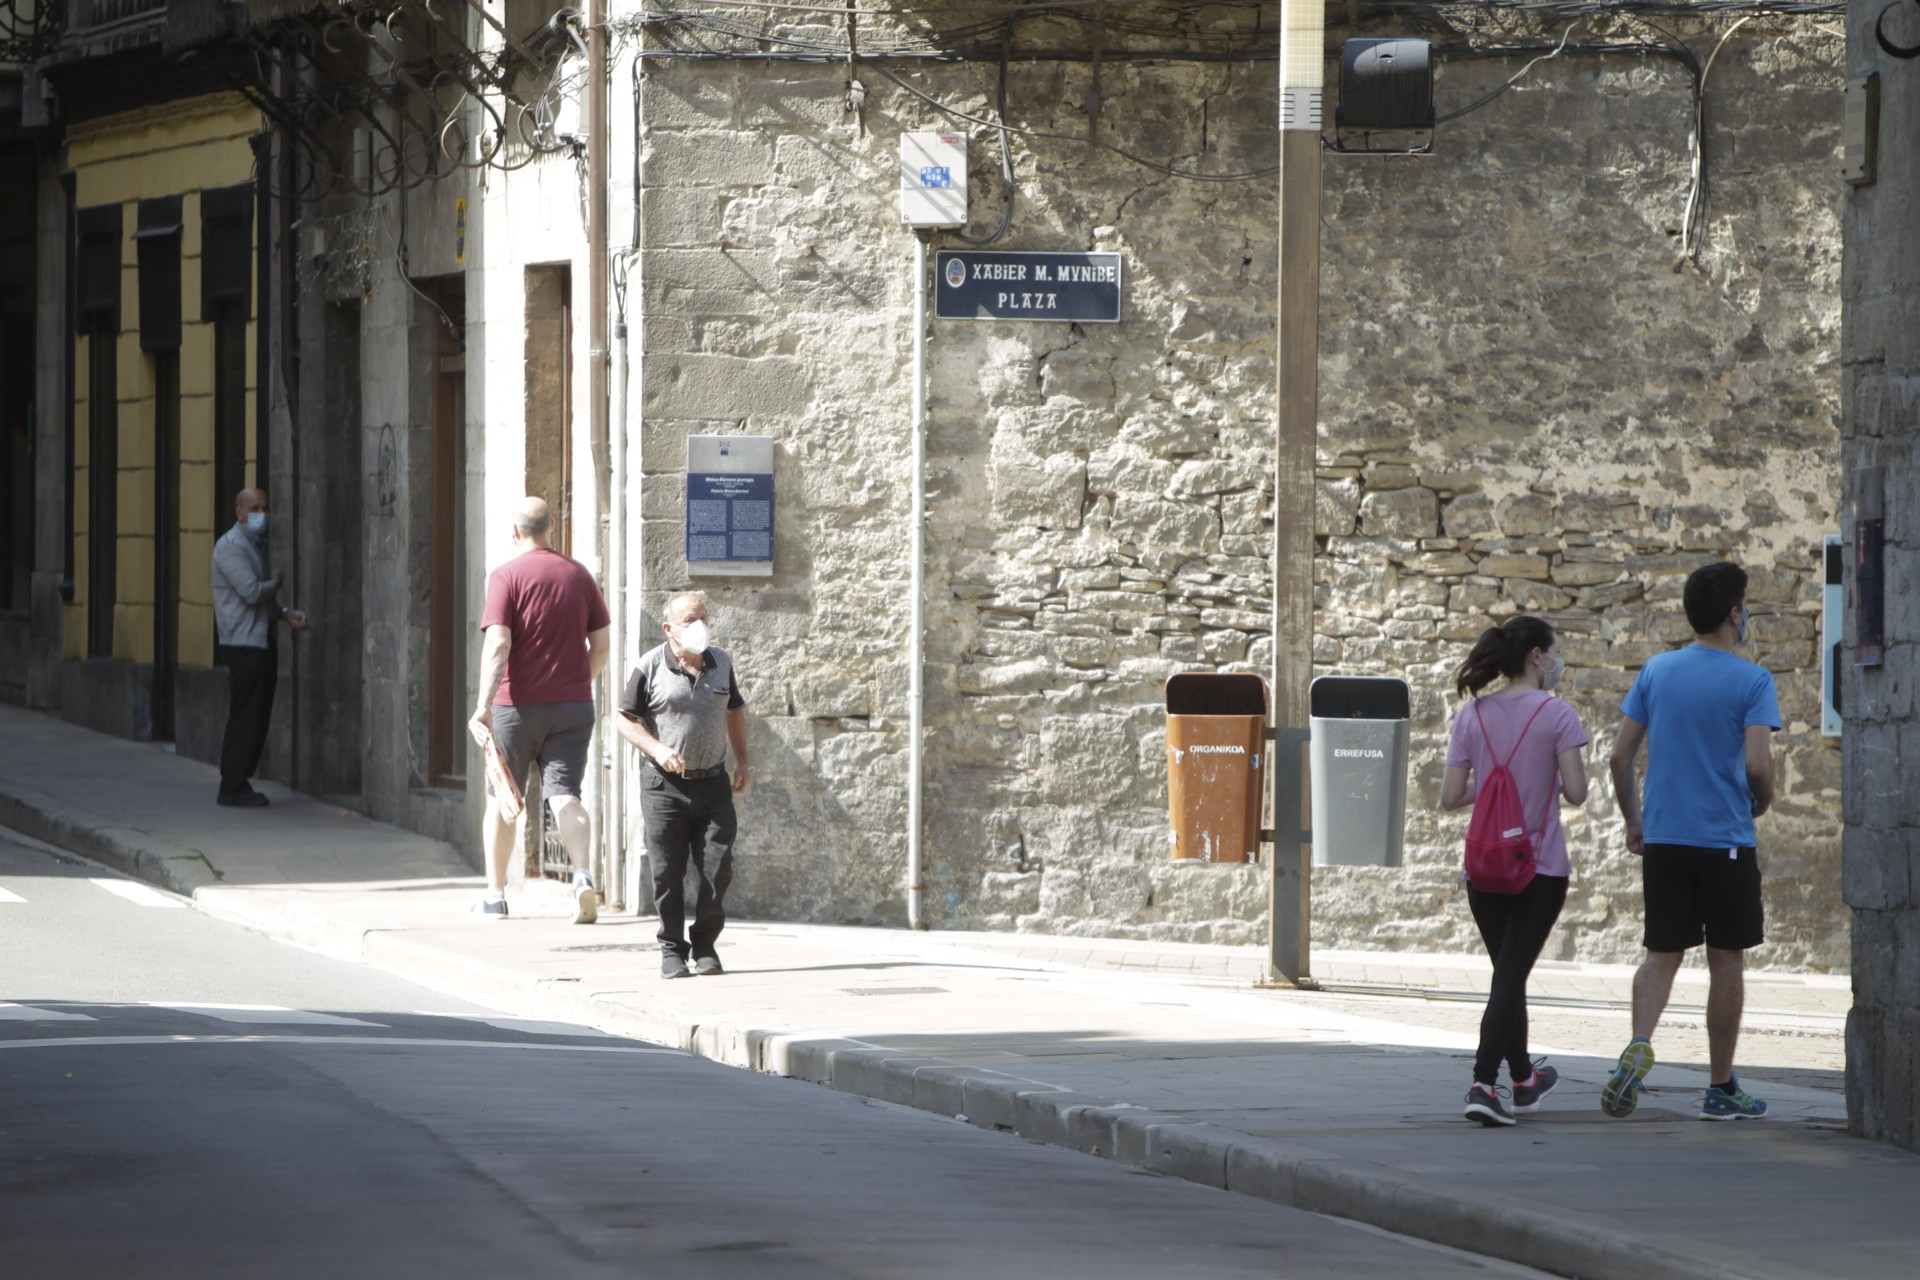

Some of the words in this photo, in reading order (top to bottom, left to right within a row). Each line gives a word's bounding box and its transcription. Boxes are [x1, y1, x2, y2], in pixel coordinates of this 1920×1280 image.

[1034, 265, 1053, 281] M.
[997, 292, 1058, 309] PLAZA
[1189, 744, 1245, 754] ORGANIKOA
[1334, 748, 1384, 758] ERREFUSA
